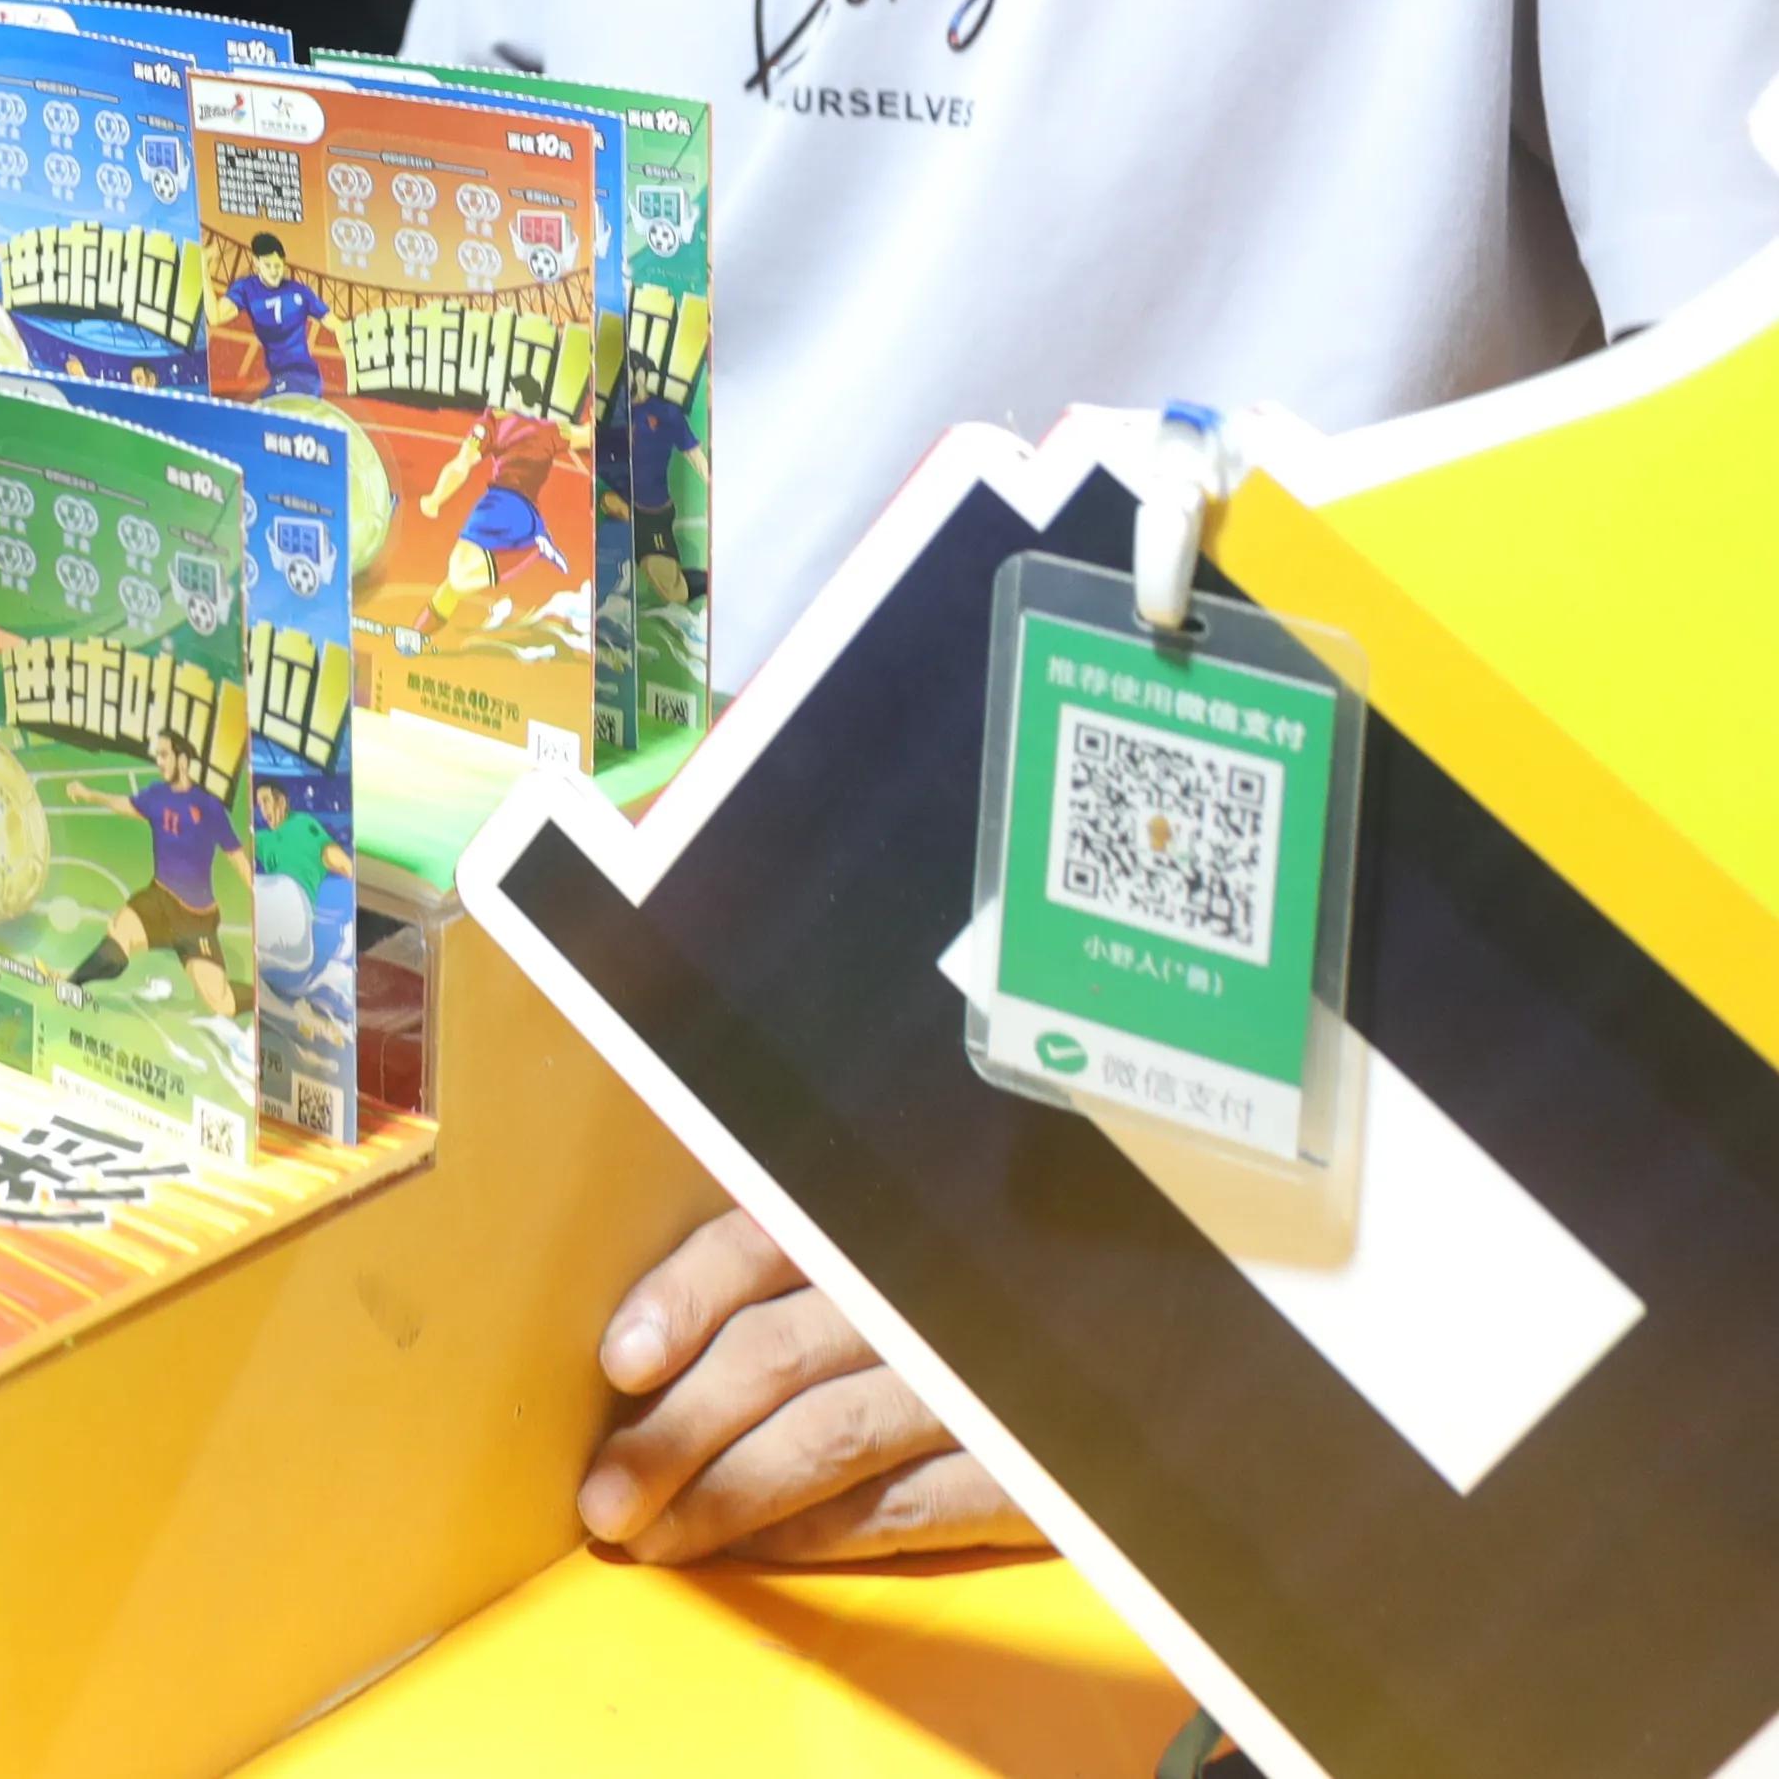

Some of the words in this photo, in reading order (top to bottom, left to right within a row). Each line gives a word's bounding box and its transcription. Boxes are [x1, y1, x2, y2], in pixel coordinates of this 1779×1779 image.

[133, 60, 182, 89] 面值10元
[627, 107, 692, 137] 面值10元
[789, 85, 976, 128] URSELVES
[507, 130, 573, 161] 面值10元
[1, 220, 205, 349] 进球啦!
[264, 298, 284, 324] 7
[343, 299, 593, 425] 进球啦!
[264, 432, 331, 465] 面值10元
[166, 465, 225, 503] 面值10元
[406, 671, 520, 723] 最高奖金40万元
[1045, 655, 1307, 753] 推荐使用微信支付
[2, 636, 248, 806] 进球啦!
[67, 1026, 186, 1096] 最高奖金40万元
[1102, 1052, 1256, 1131] 微信支付
